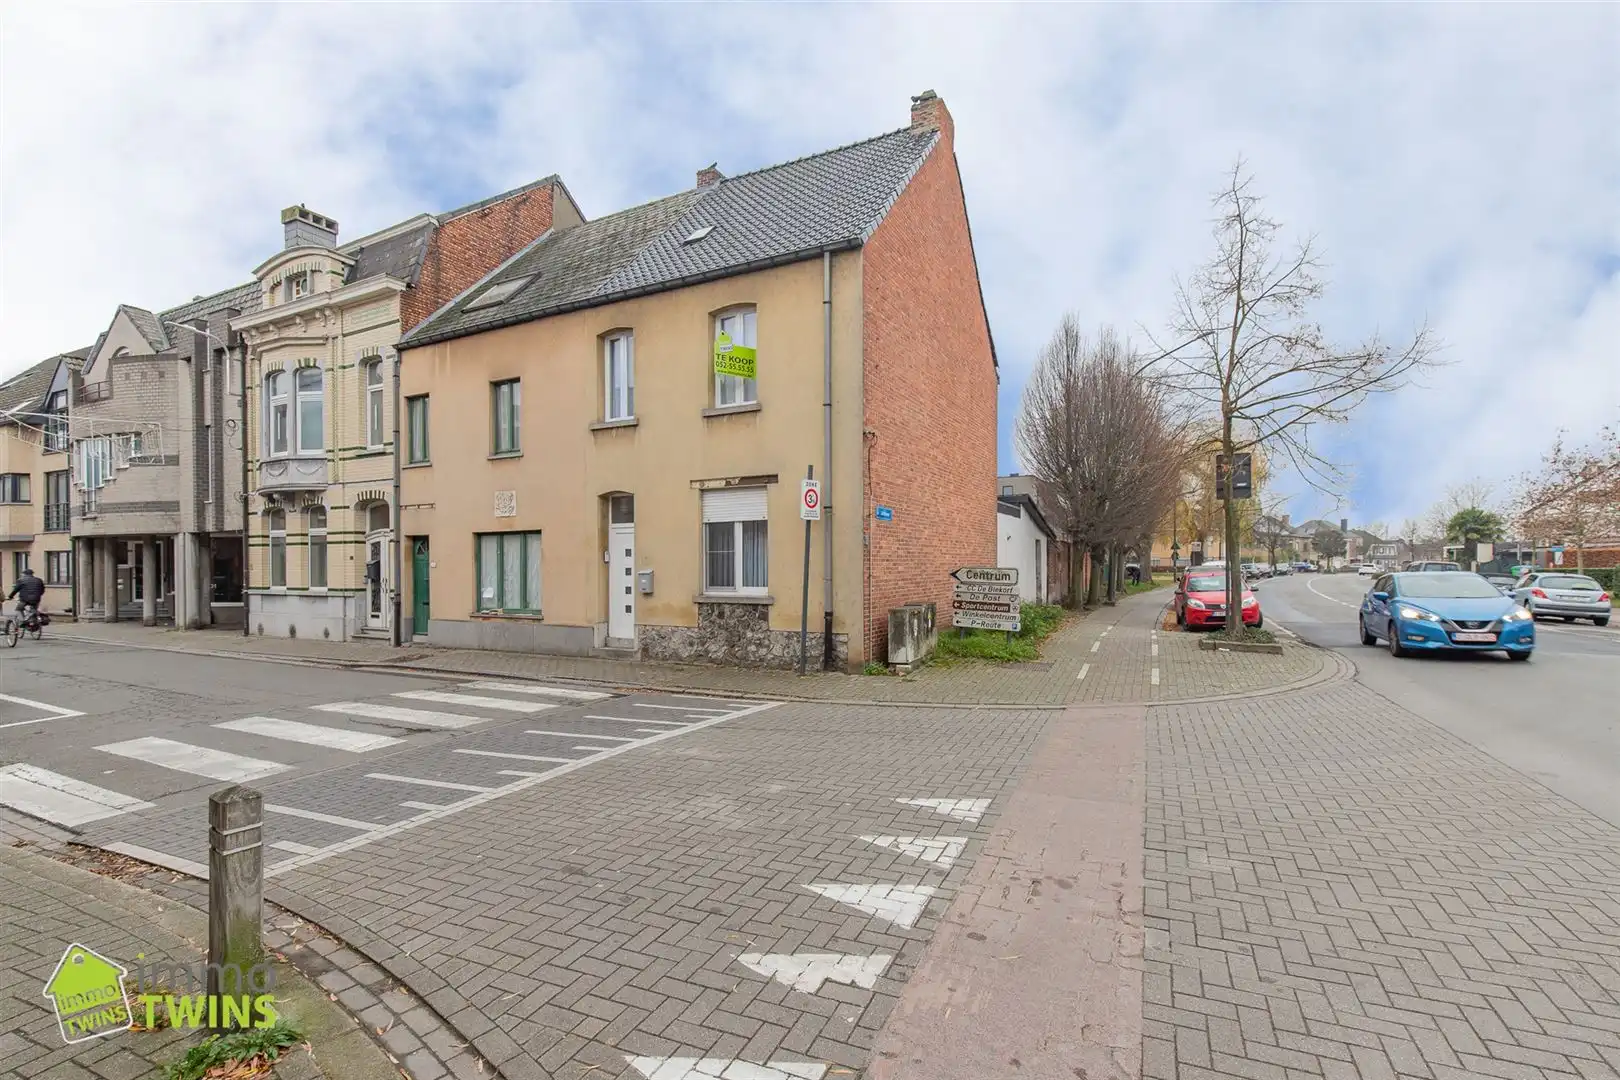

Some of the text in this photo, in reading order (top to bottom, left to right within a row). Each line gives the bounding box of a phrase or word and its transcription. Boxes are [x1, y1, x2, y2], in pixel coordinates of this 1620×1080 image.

[715, 353, 754, 366] TE KOOP
[966, 570, 1011, 581] Centrum
[969, 593, 1001, 602] De Post
[960, 602, 1009, 612] Sportcentrum
[962, 611, 1017, 621] Winkelcentrum
[970, 620, 1002, 629] P-Route
